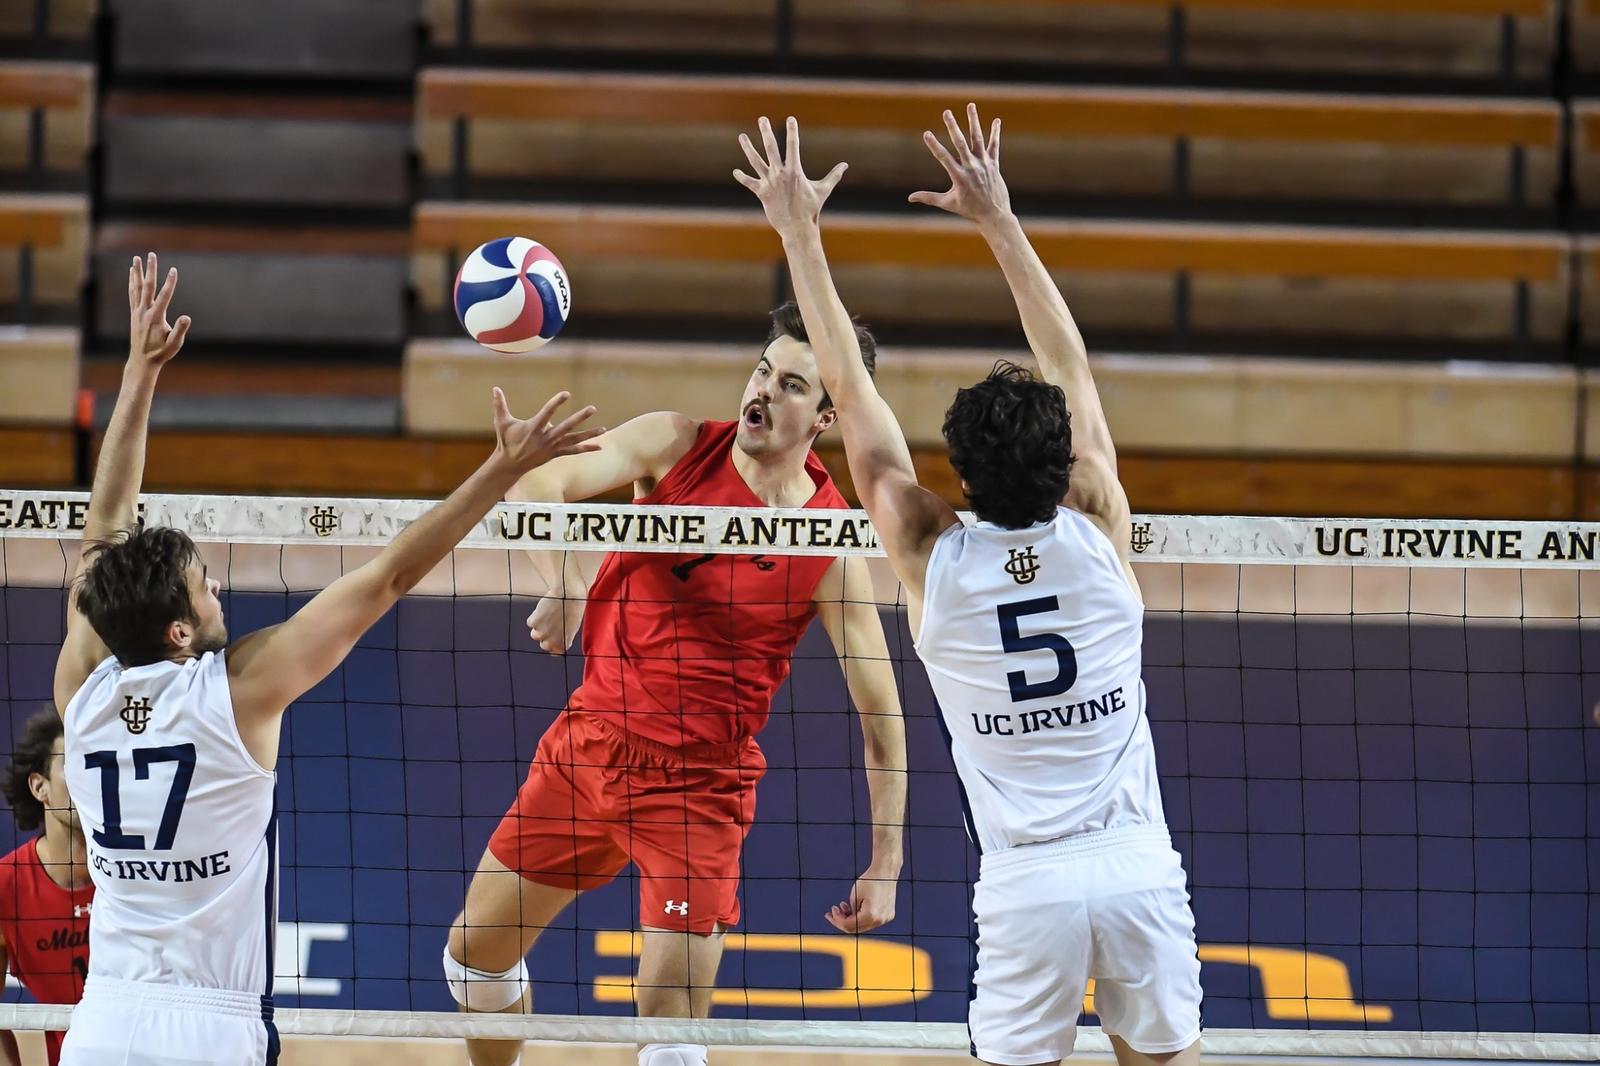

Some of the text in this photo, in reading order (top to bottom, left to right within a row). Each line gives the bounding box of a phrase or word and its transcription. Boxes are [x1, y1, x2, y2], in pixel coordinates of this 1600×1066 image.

[498, 511, 552, 542] UC
[563, 513, 706, 544] IRVINE
[1315, 527, 1368, 557] UC
[1382, 528, 1523, 560] IRVINE
[996, 594, 1079, 703] 5
[971, 687, 1126, 736] UC IRVINE
[84, 743, 197, 851] 17
[114, 850, 231, 883] IRVINE
